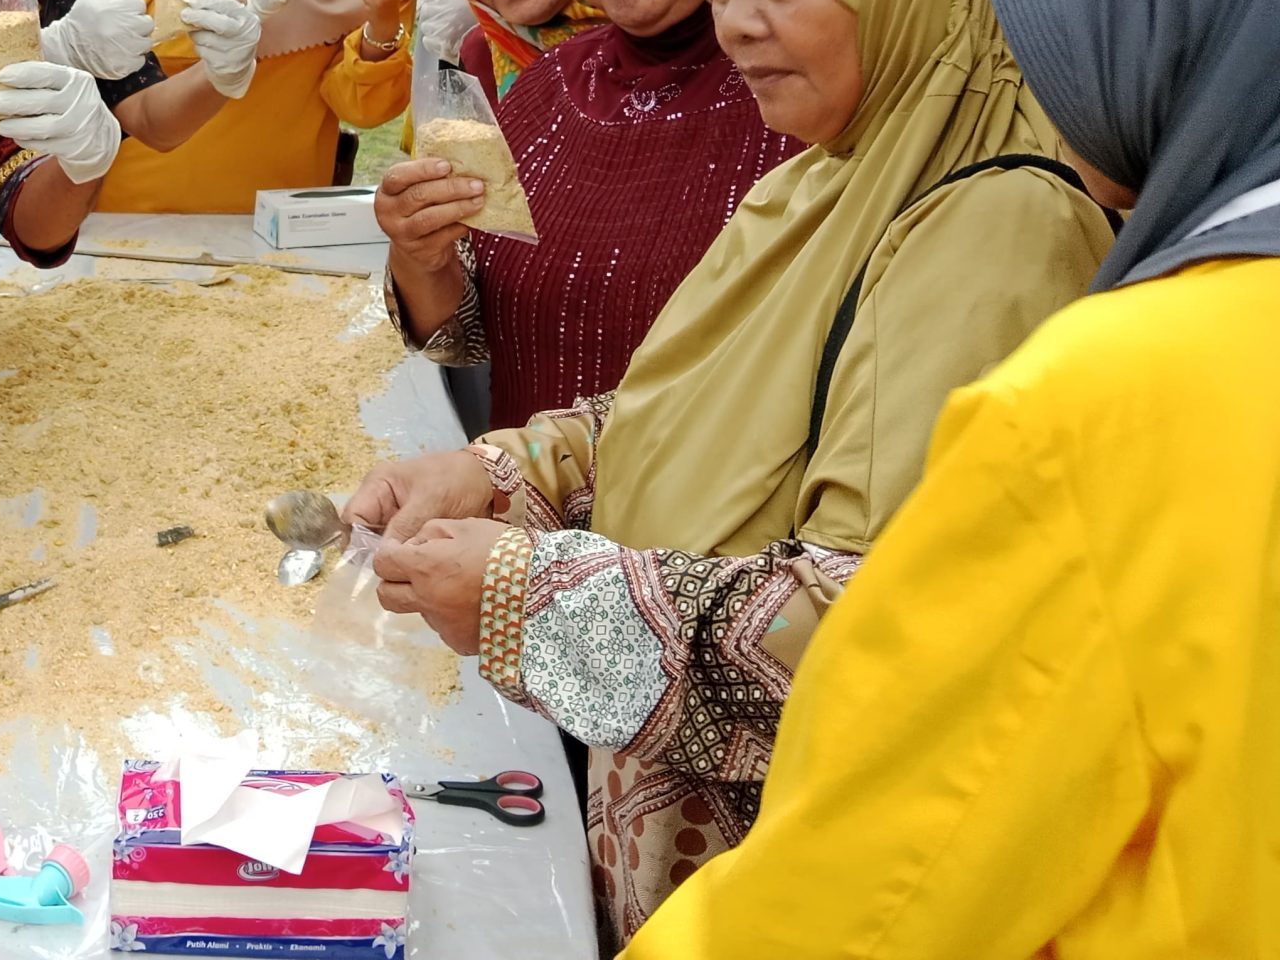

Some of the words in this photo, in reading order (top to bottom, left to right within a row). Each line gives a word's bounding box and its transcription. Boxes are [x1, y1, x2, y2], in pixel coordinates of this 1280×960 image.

[185, 940, 206, 949] Putih
[206, 941, 229, 950] Alami
[246, 942, 273, 951] Praktis
[289, 943, 326, 951] Ekonomis
